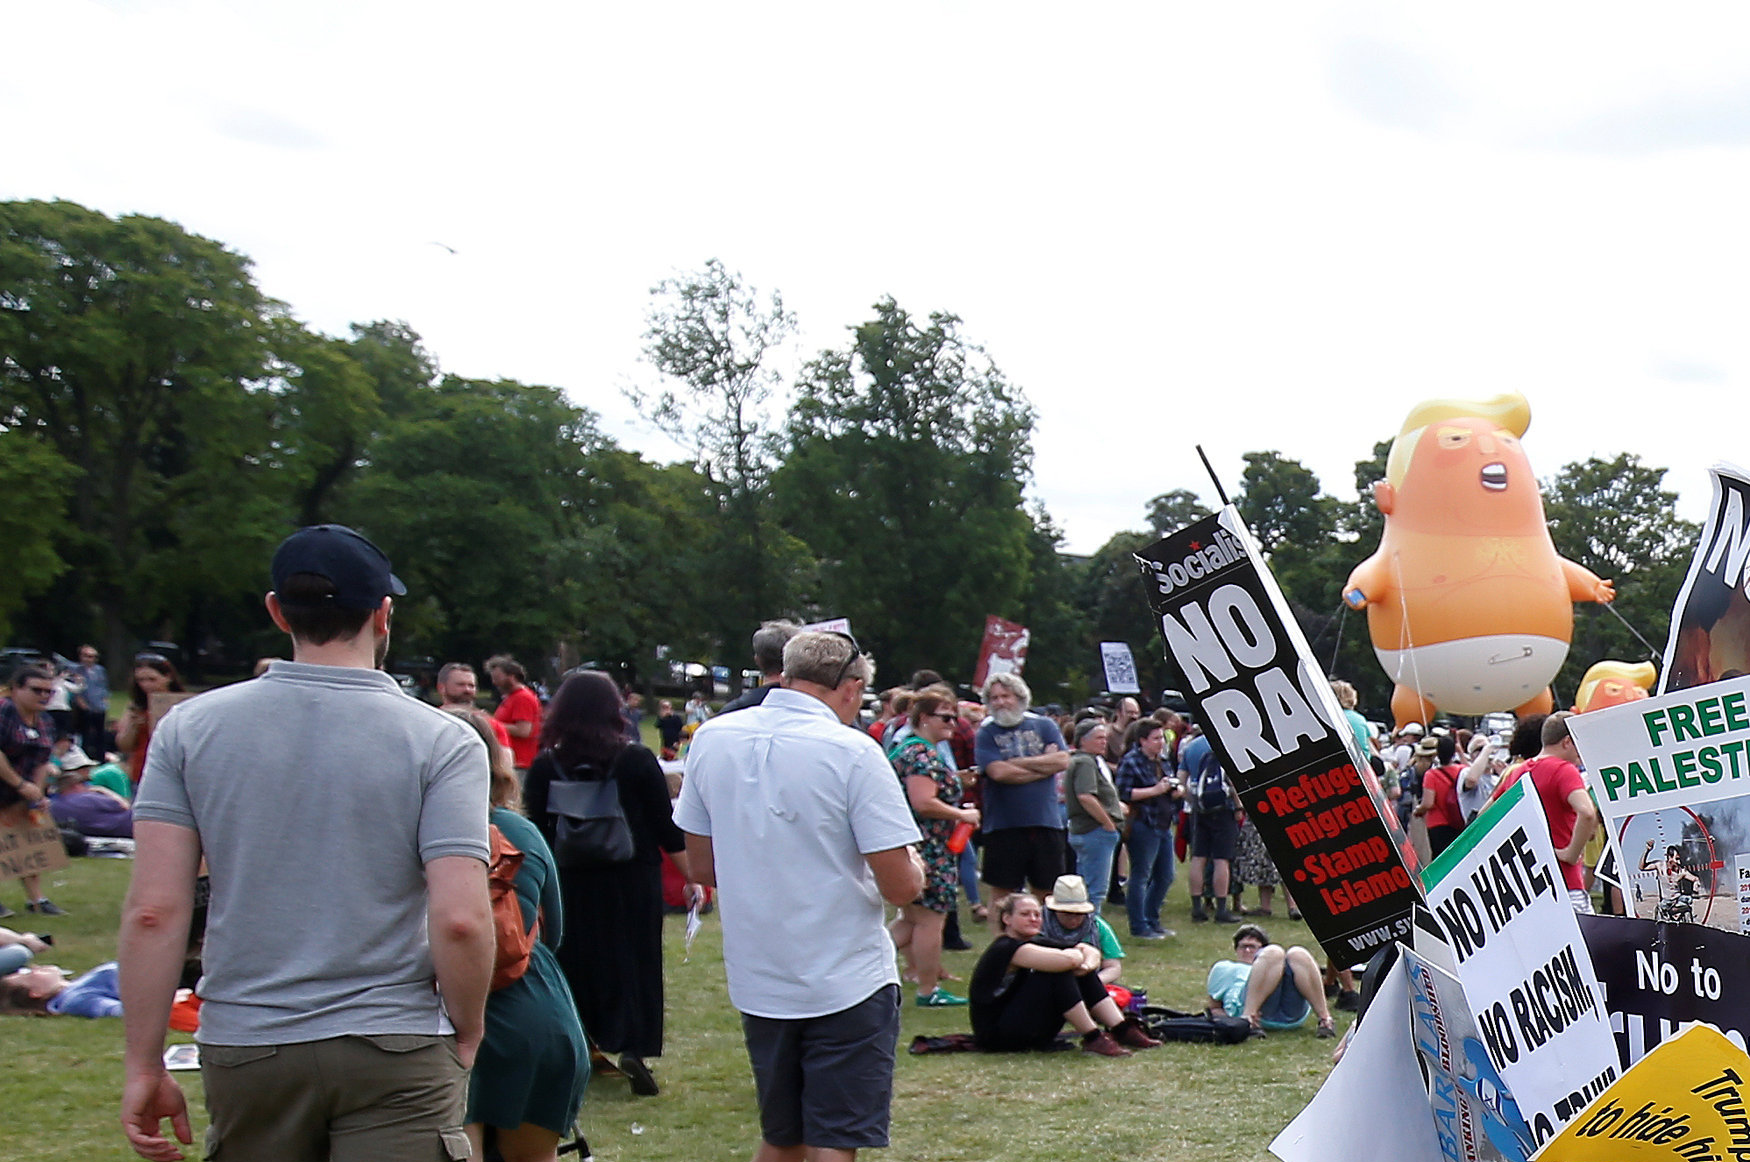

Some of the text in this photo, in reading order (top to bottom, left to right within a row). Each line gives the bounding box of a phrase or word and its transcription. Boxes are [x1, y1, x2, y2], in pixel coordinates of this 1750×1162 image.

[1162, 584, 1277, 694] NO
[1642, 692, 1750, 748] FREE
[1304, 836, 1390, 885] Stamp
[1320, 865, 1410, 915] Islamo
[1436, 826, 1558, 964] NO HATE,
[1635, 950, 1722, 1000] No to
[1478, 1001, 1519, 1073] NO
[1510, 945, 1600, 1052] RACISM,
[1575, 1098, 1624, 1138] to
[1608, 1102, 1691, 1145] hide
